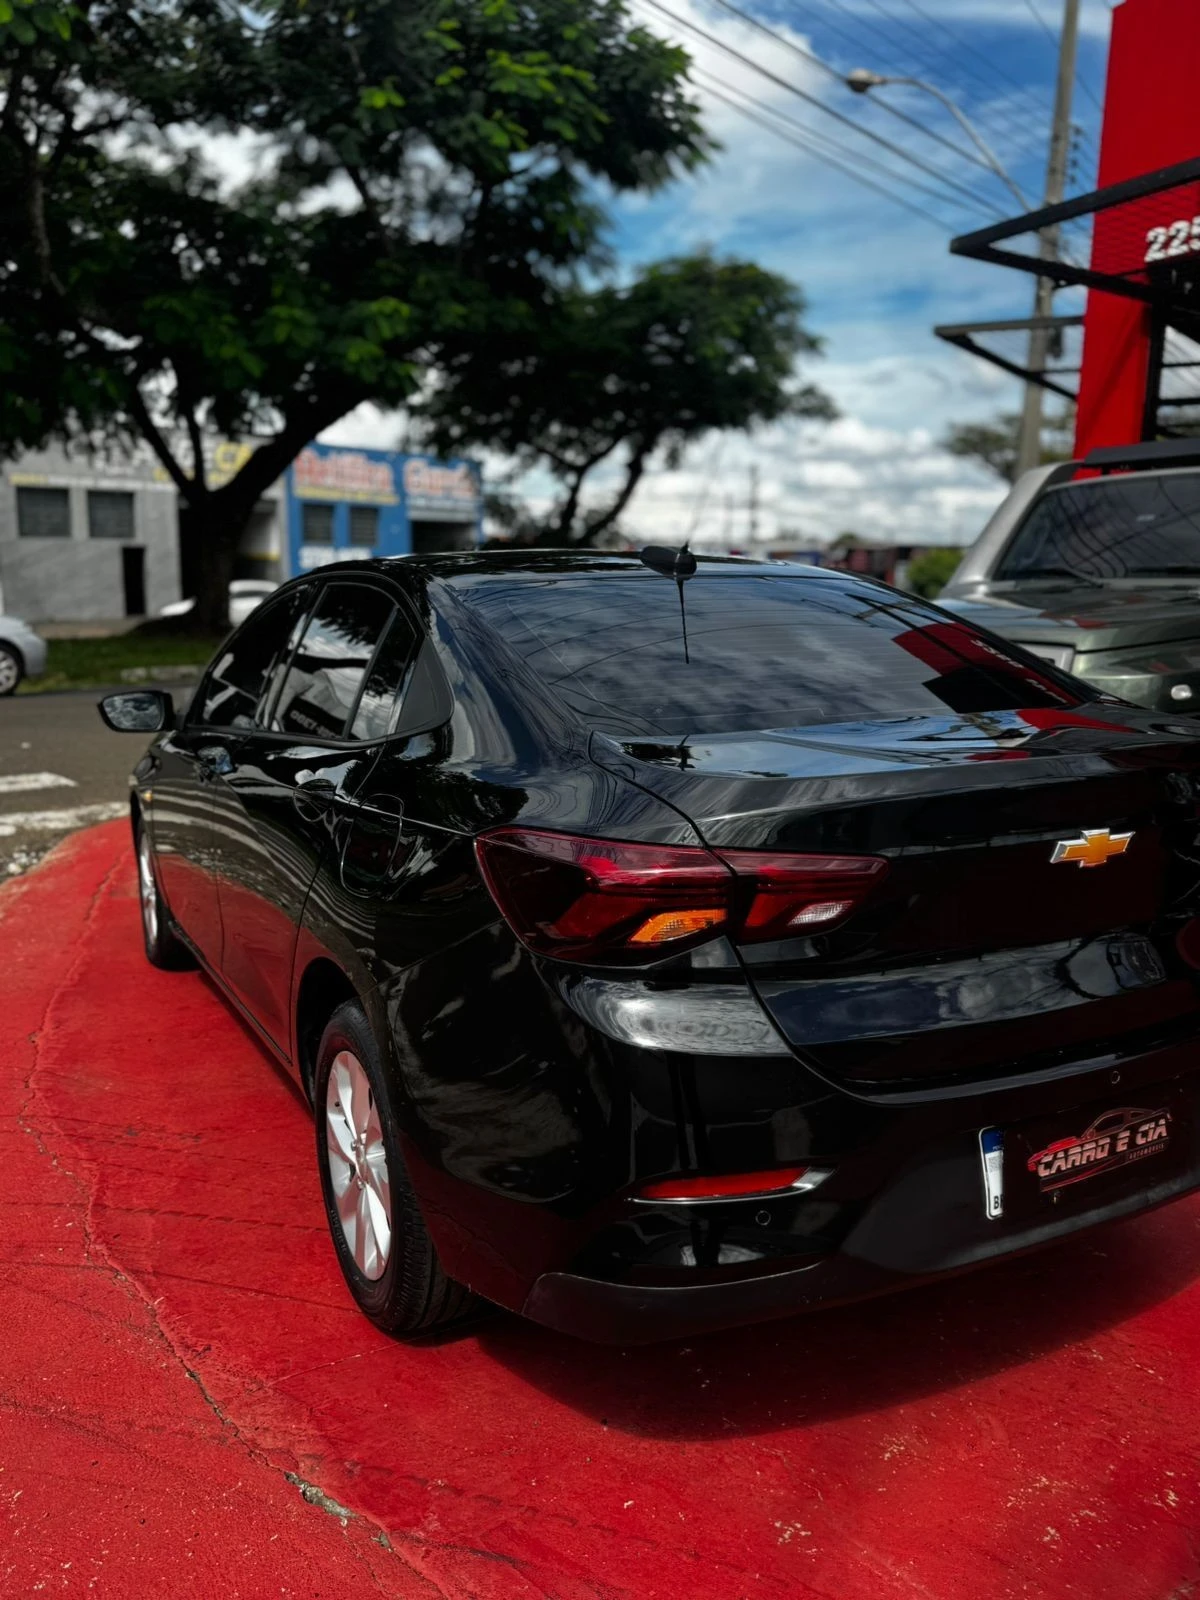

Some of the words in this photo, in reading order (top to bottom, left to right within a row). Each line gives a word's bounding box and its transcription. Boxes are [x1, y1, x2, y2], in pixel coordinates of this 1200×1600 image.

[1037, 1136, 1111, 1177] CARRO
[1116, 1129, 1131, 1153] E
[1135, 1118, 1167, 1146] CIA
